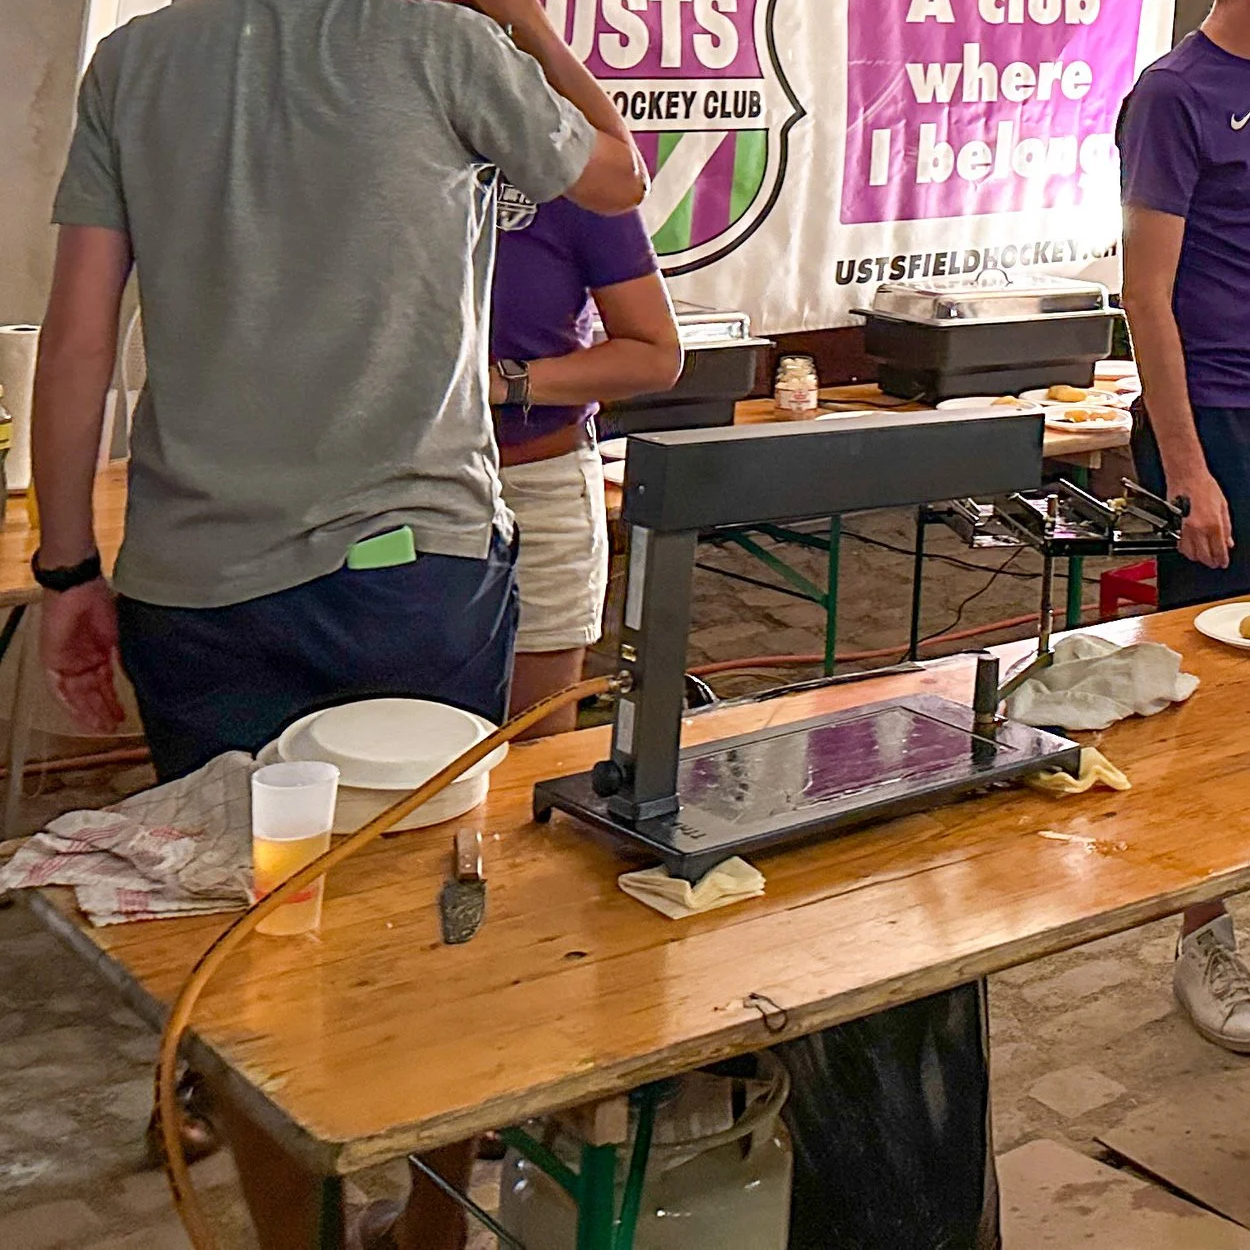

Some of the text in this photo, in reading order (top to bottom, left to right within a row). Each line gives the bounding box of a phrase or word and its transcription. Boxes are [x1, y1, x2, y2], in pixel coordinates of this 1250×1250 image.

[905, 42, 1093, 104] where
[607, 91, 762, 120] OCKEY CLUB
[869, 128, 891, 186] I
